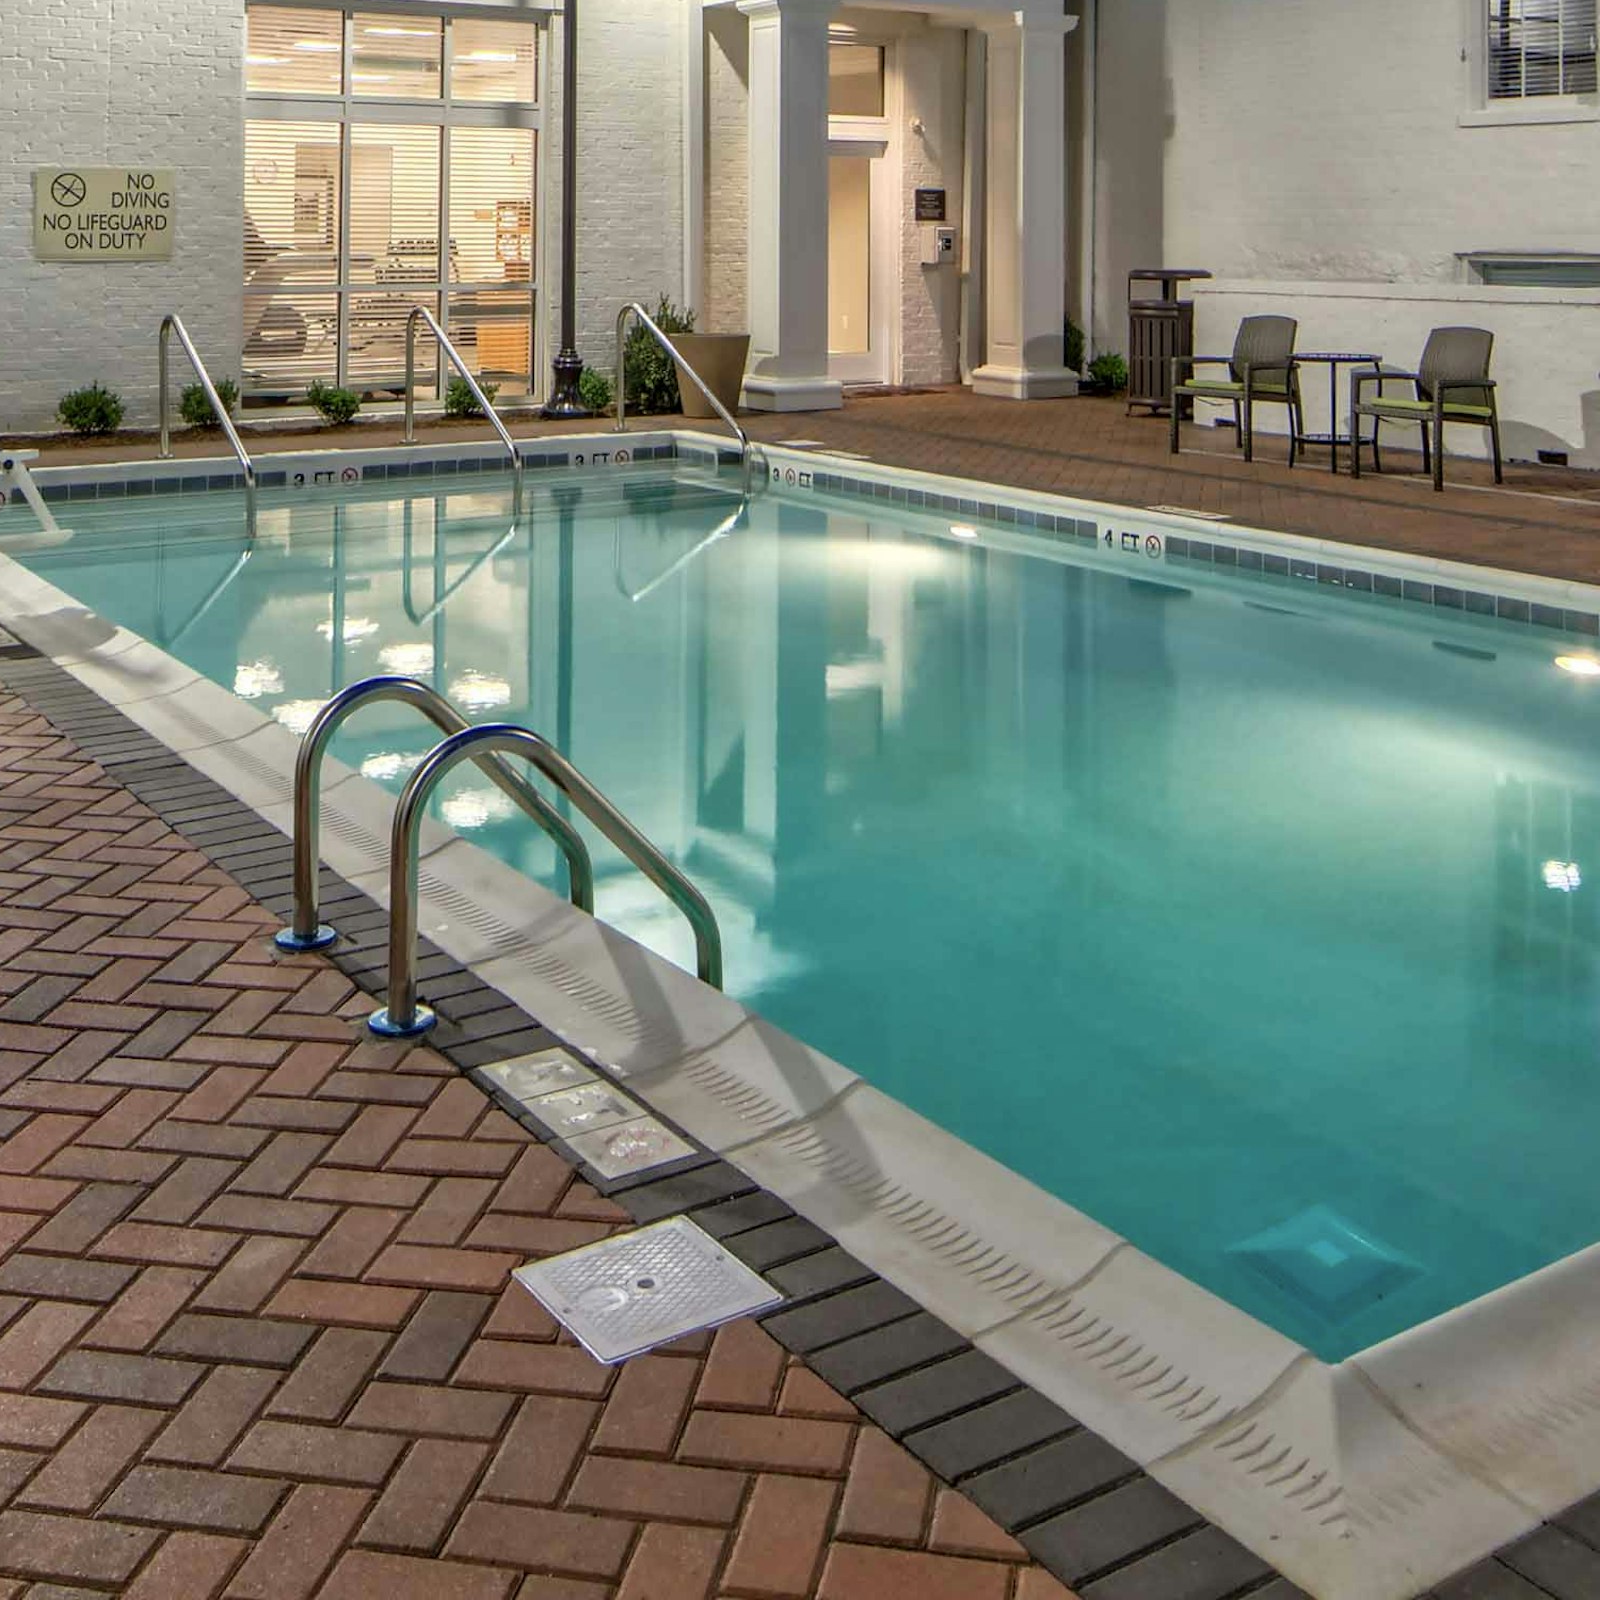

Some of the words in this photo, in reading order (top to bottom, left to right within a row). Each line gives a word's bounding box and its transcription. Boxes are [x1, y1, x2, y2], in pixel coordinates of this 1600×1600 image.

[127, 174, 155, 190] NO
[111, 192, 170, 209] DIVING
[43, 214, 72, 230] NO
[77, 214, 167, 231] LIFEGUARD
[64, 233, 93, 249] ON
[99, 233, 147, 249] DUTY
